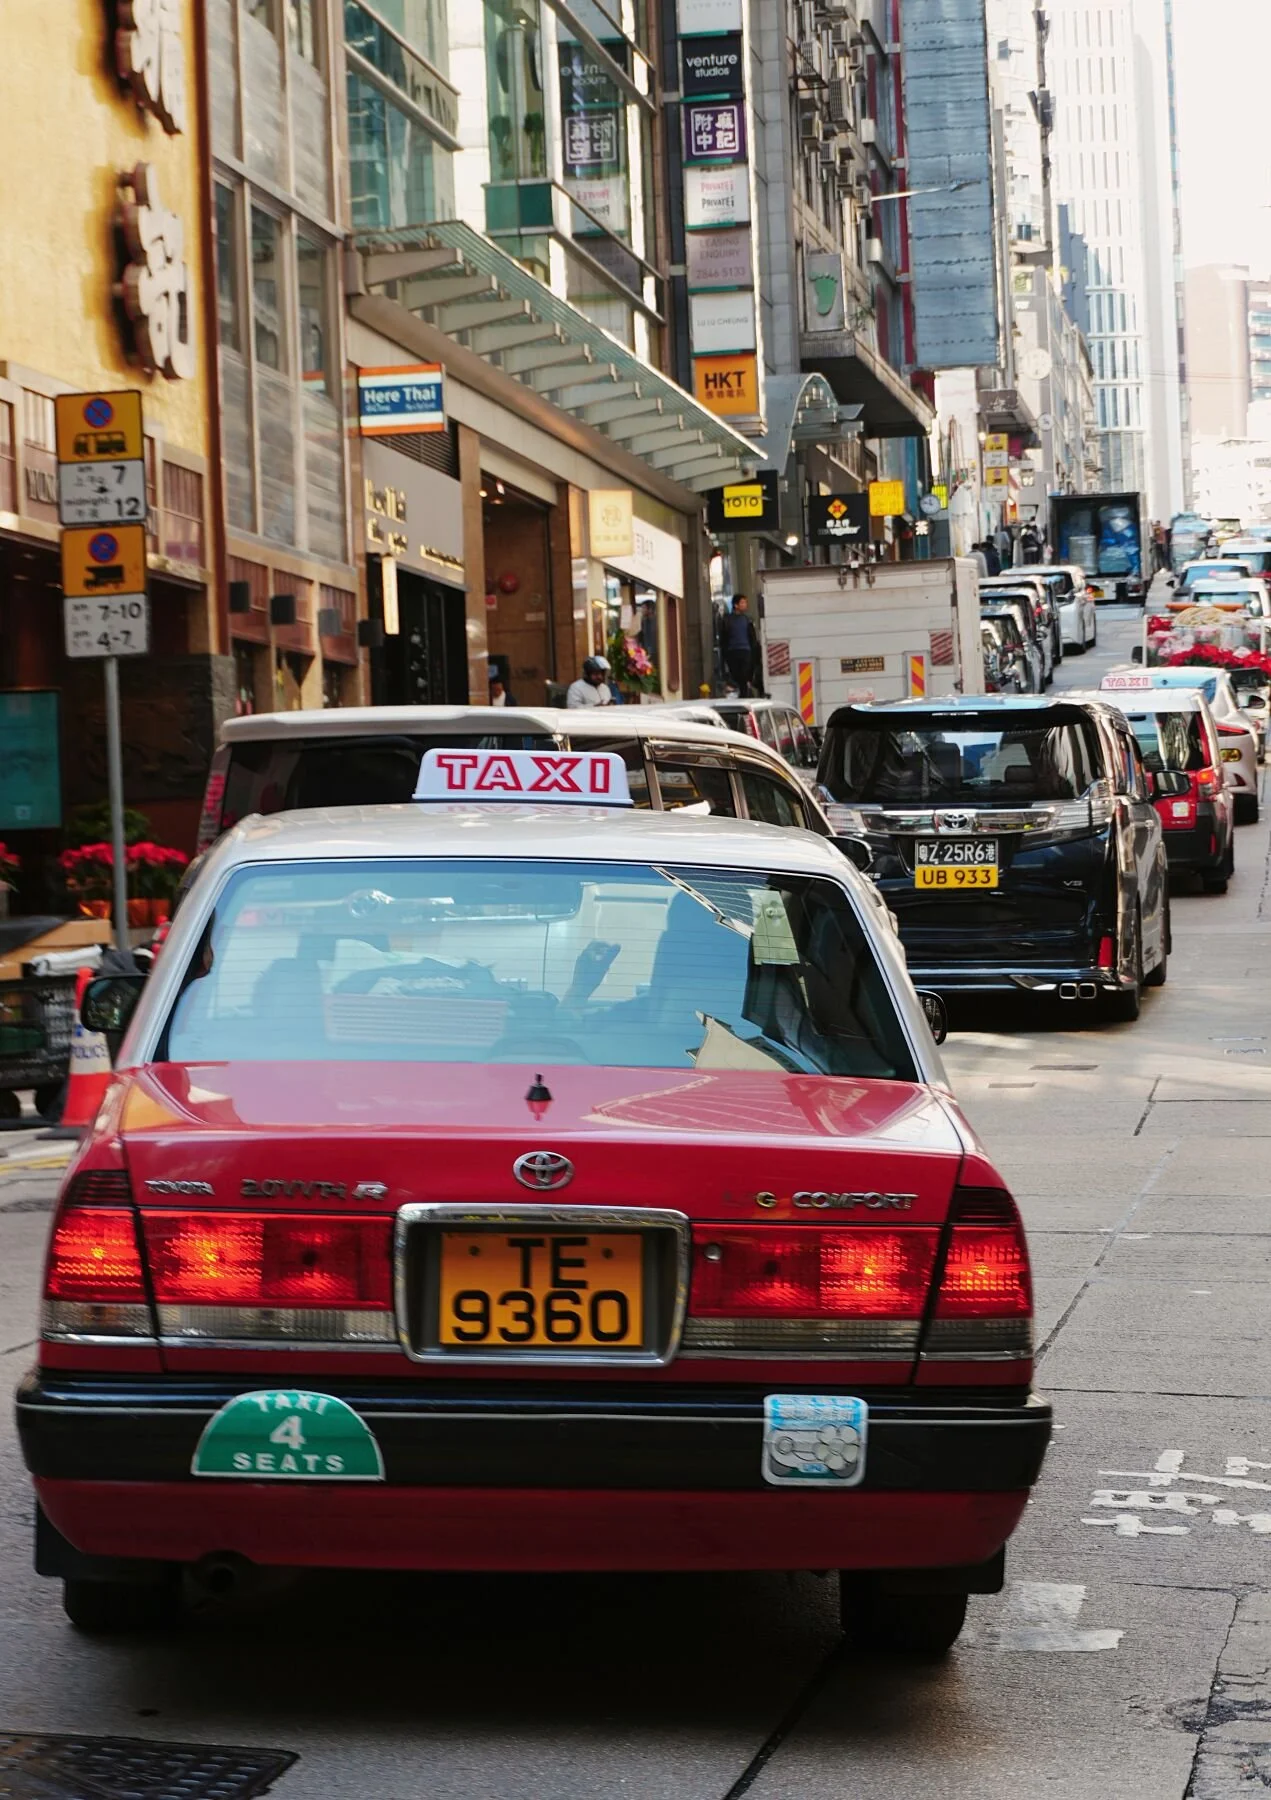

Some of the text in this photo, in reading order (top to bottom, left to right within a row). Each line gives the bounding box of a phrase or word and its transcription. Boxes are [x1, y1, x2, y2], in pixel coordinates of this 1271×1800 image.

[686, 54, 737, 67] venture
[695, 66, 730, 78] studios
[700, 248, 740, 259] ENQUIRY
[704, 370, 746, 389] HKT
[364, 384, 436, 405] Here Thai
[111, 464, 126, 485] 7
[115, 496, 140, 517] 12
[97, 602, 142, 621] 7-10
[96, 629, 132, 651] 4-7
[1104, 677, 1149, 687] TAXI
[436, 755, 610, 793] TAXI
[922, 869, 992, 885] UB 933
[755, 1191, 919, 1210] G COMFORT
[507, 1237, 589, 1289] TE
[451, 1289, 629, 1343] 9360
[253, 1393, 332, 1416] TAXI
[269, 1415, 308, 1451] 4
[232, 1452, 345, 1473] SEATS
